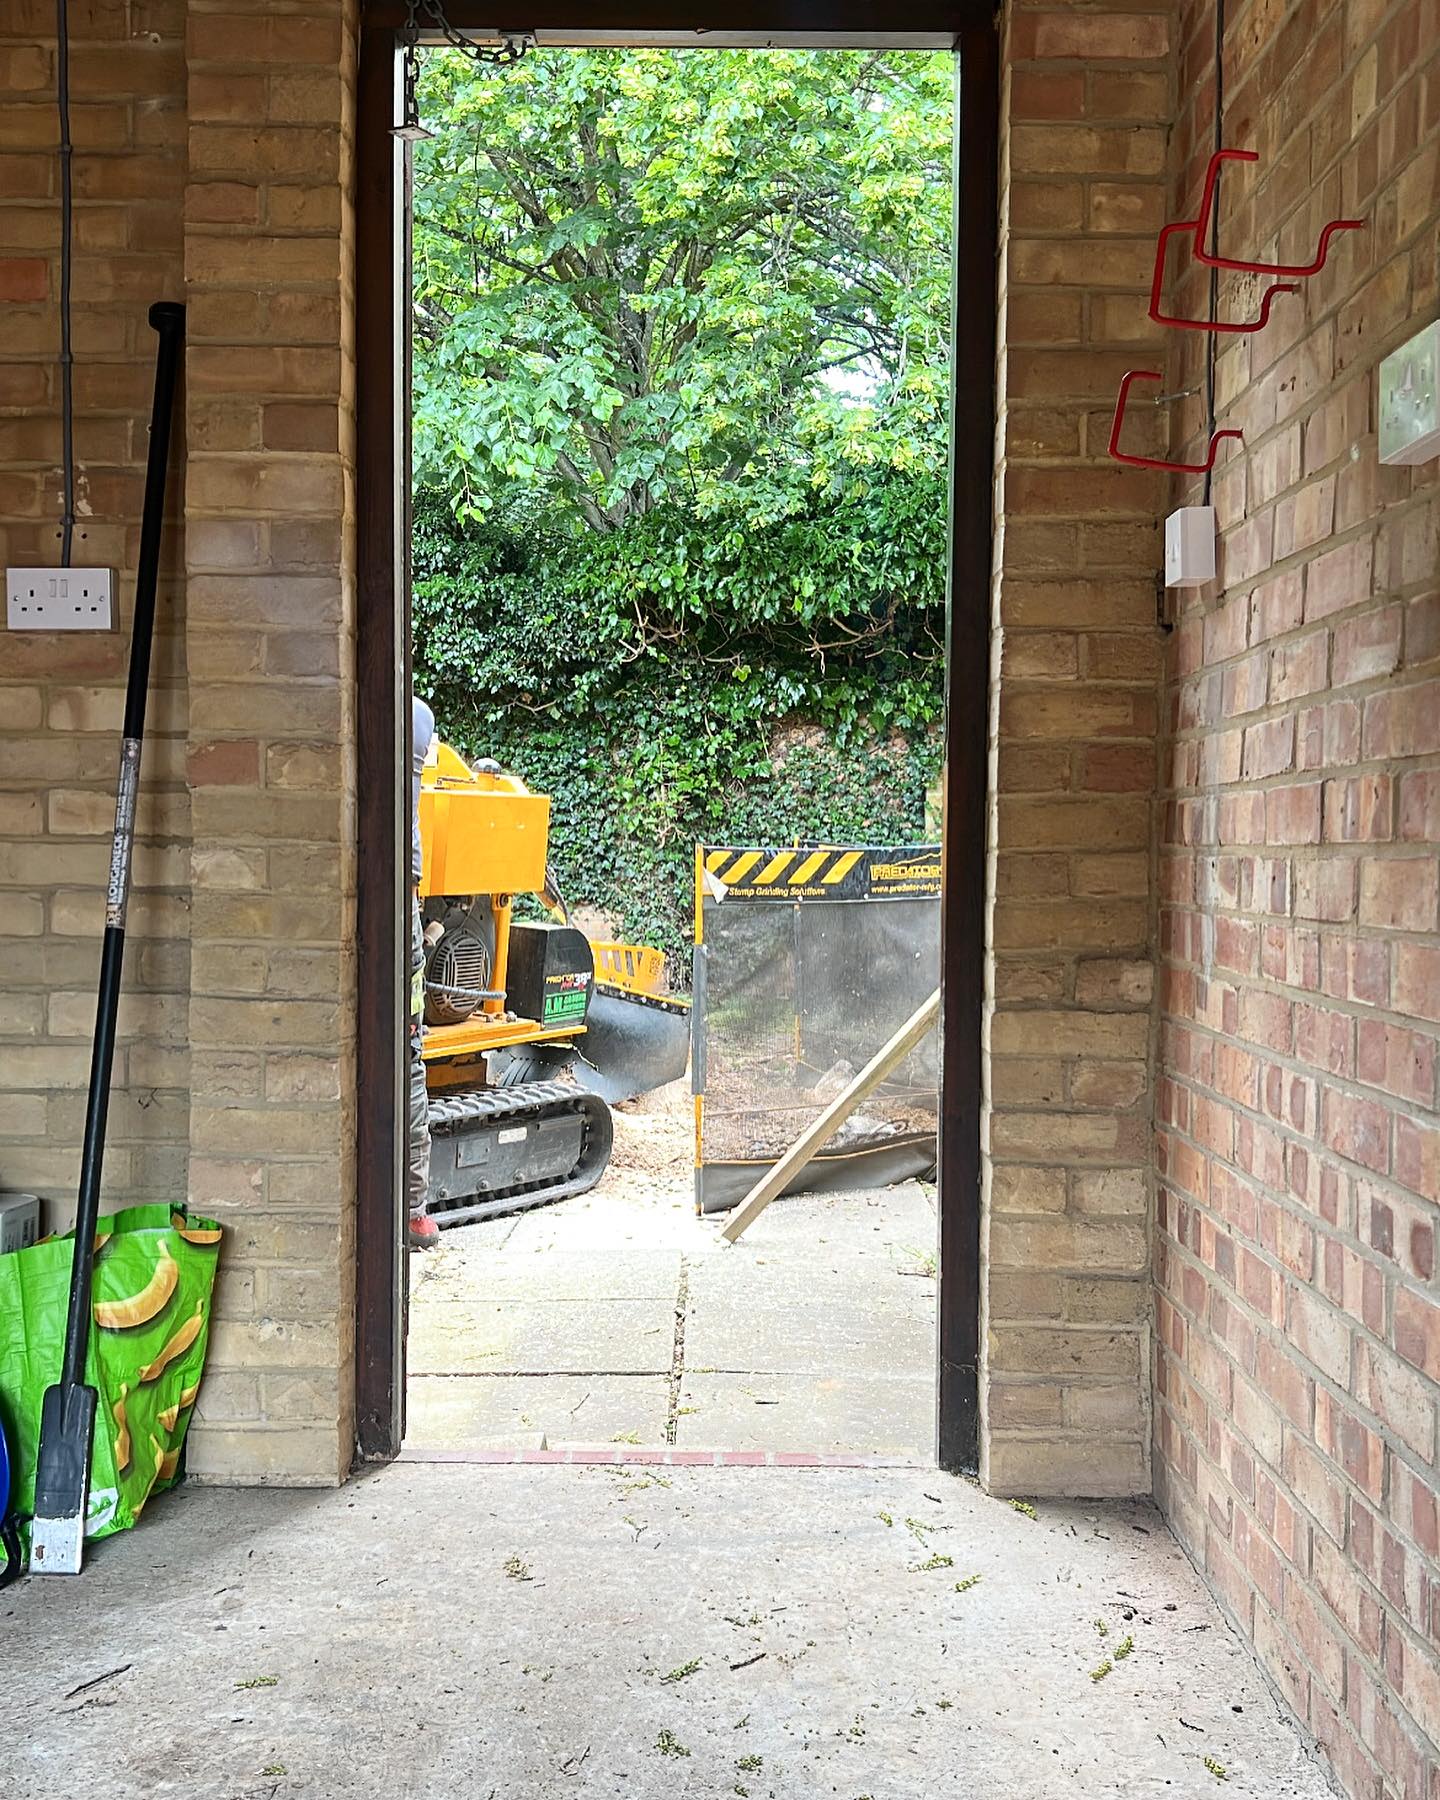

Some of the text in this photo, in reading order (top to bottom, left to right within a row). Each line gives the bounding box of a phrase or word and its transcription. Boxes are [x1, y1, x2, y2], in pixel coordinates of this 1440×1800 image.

[108, 834, 123, 904] ROUGHNECK
[729, 887, 754, 897] Stump
[756, 887, 788, 897] Grinding
